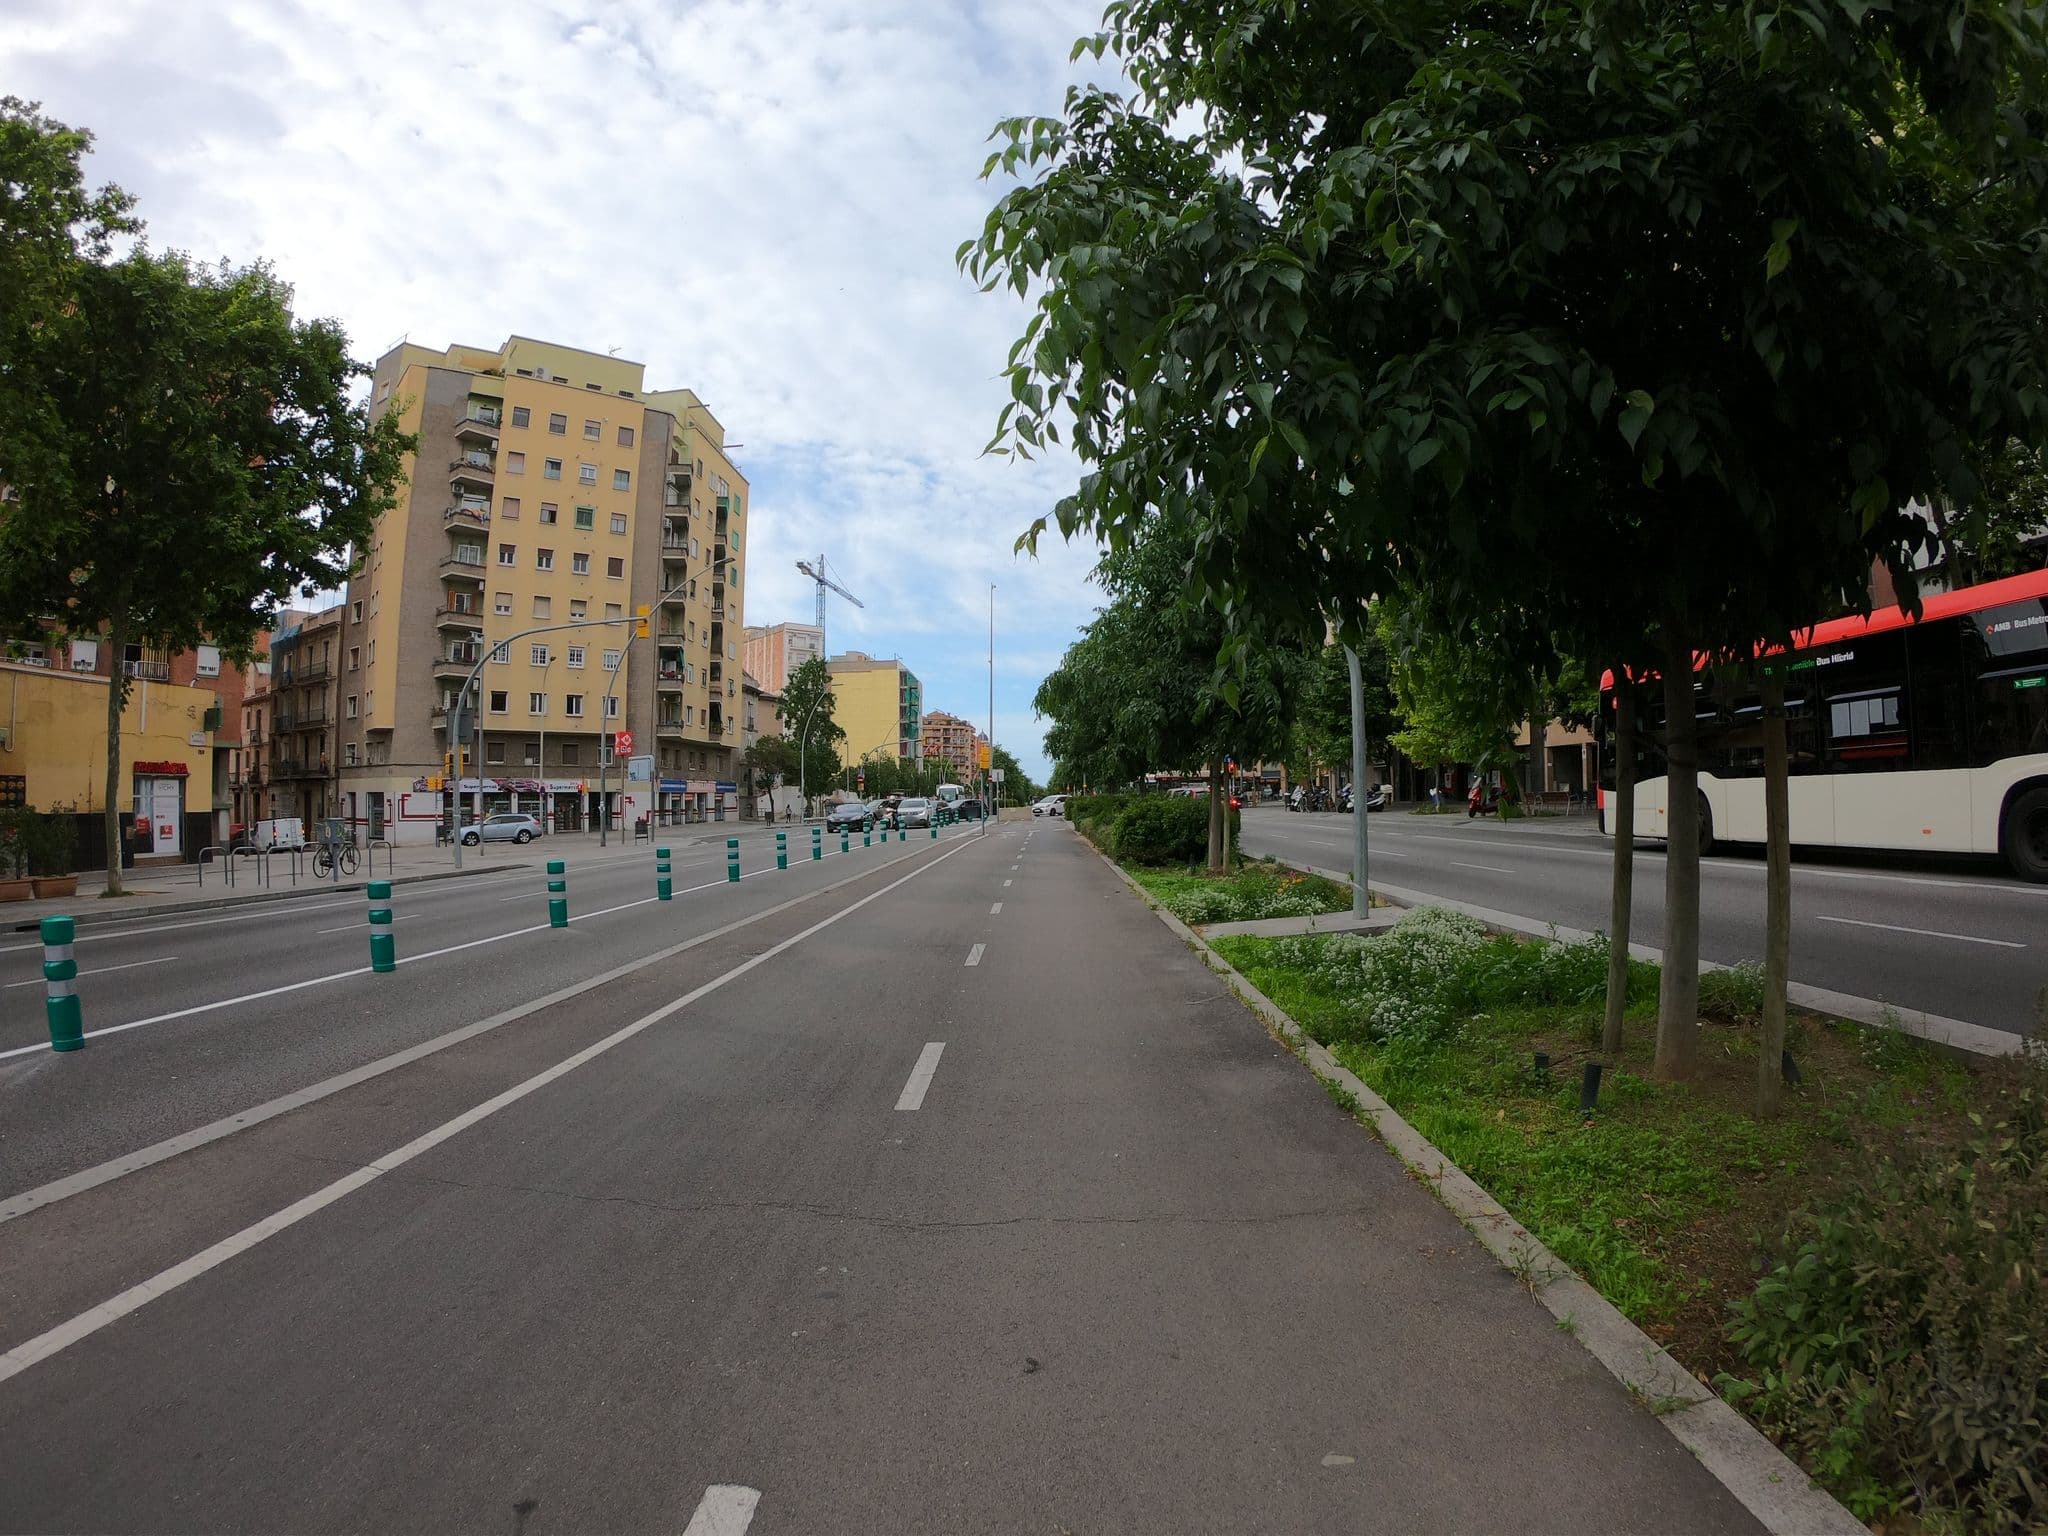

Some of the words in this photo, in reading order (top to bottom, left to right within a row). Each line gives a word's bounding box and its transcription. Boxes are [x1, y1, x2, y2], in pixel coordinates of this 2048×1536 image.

[1994, 621, 2011, 632] AMB
[2014, 618, 2028, 628] Bus
[1816, 656, 1831, 666] Bus
